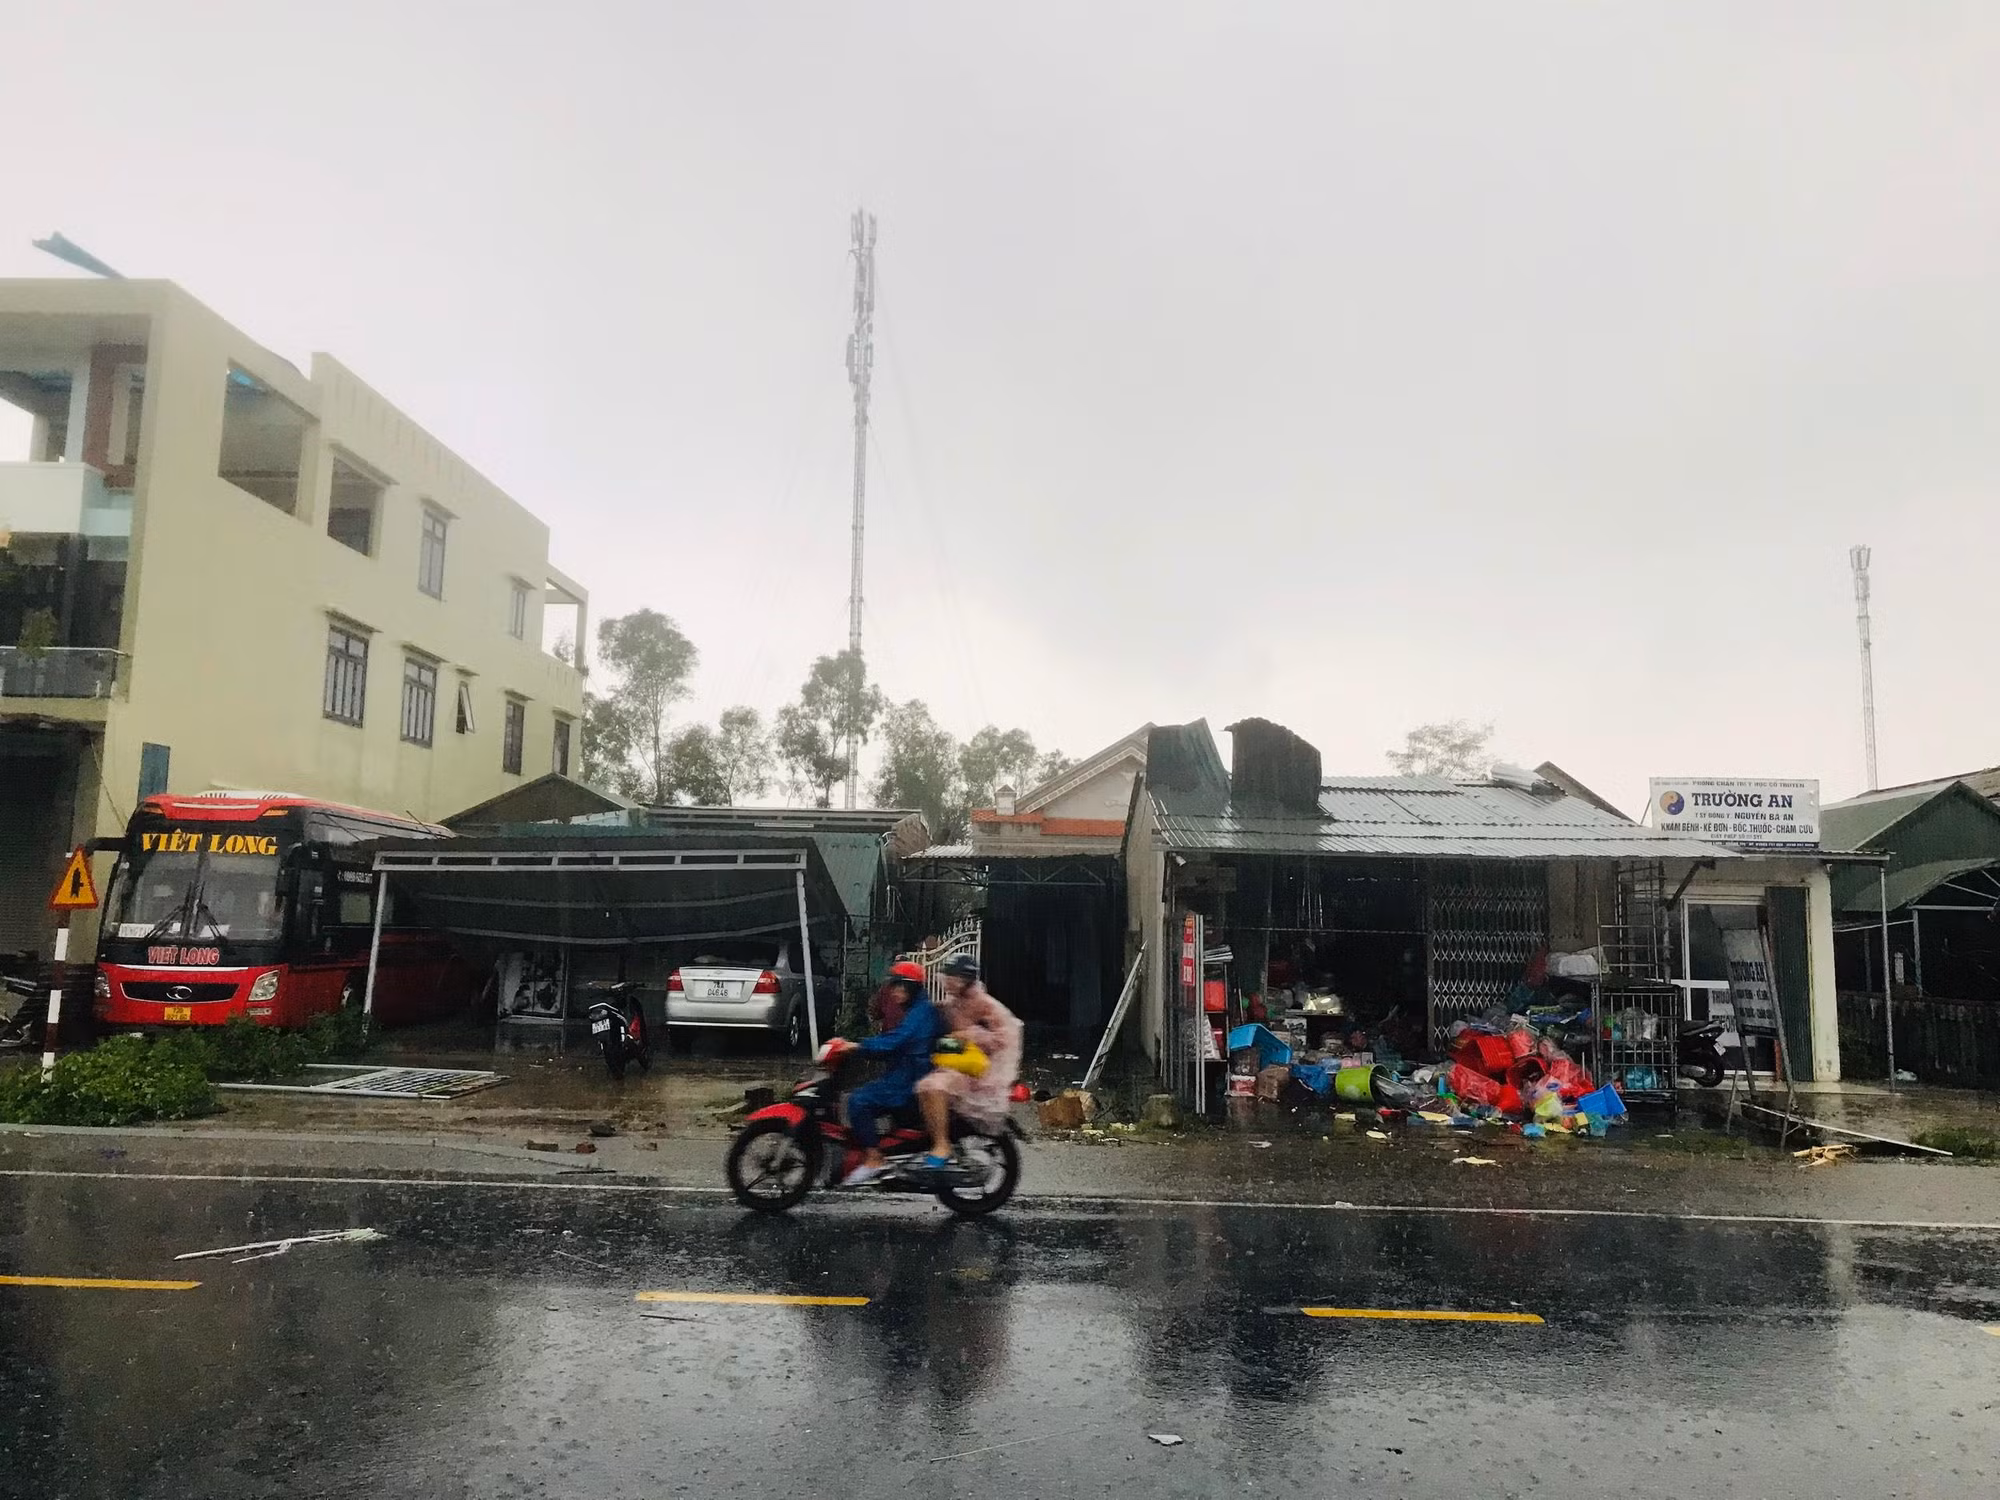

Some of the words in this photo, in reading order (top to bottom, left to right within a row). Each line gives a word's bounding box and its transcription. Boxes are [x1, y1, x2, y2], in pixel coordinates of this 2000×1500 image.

[1691, 789, 1763, 807] TRƯỜNG
[1767, 794, 1793, 808] AN
[1783, 813, 1794, 821] AN
[208, 834, 278, 855] LONG
[180, 947, 219, 965] LONG
